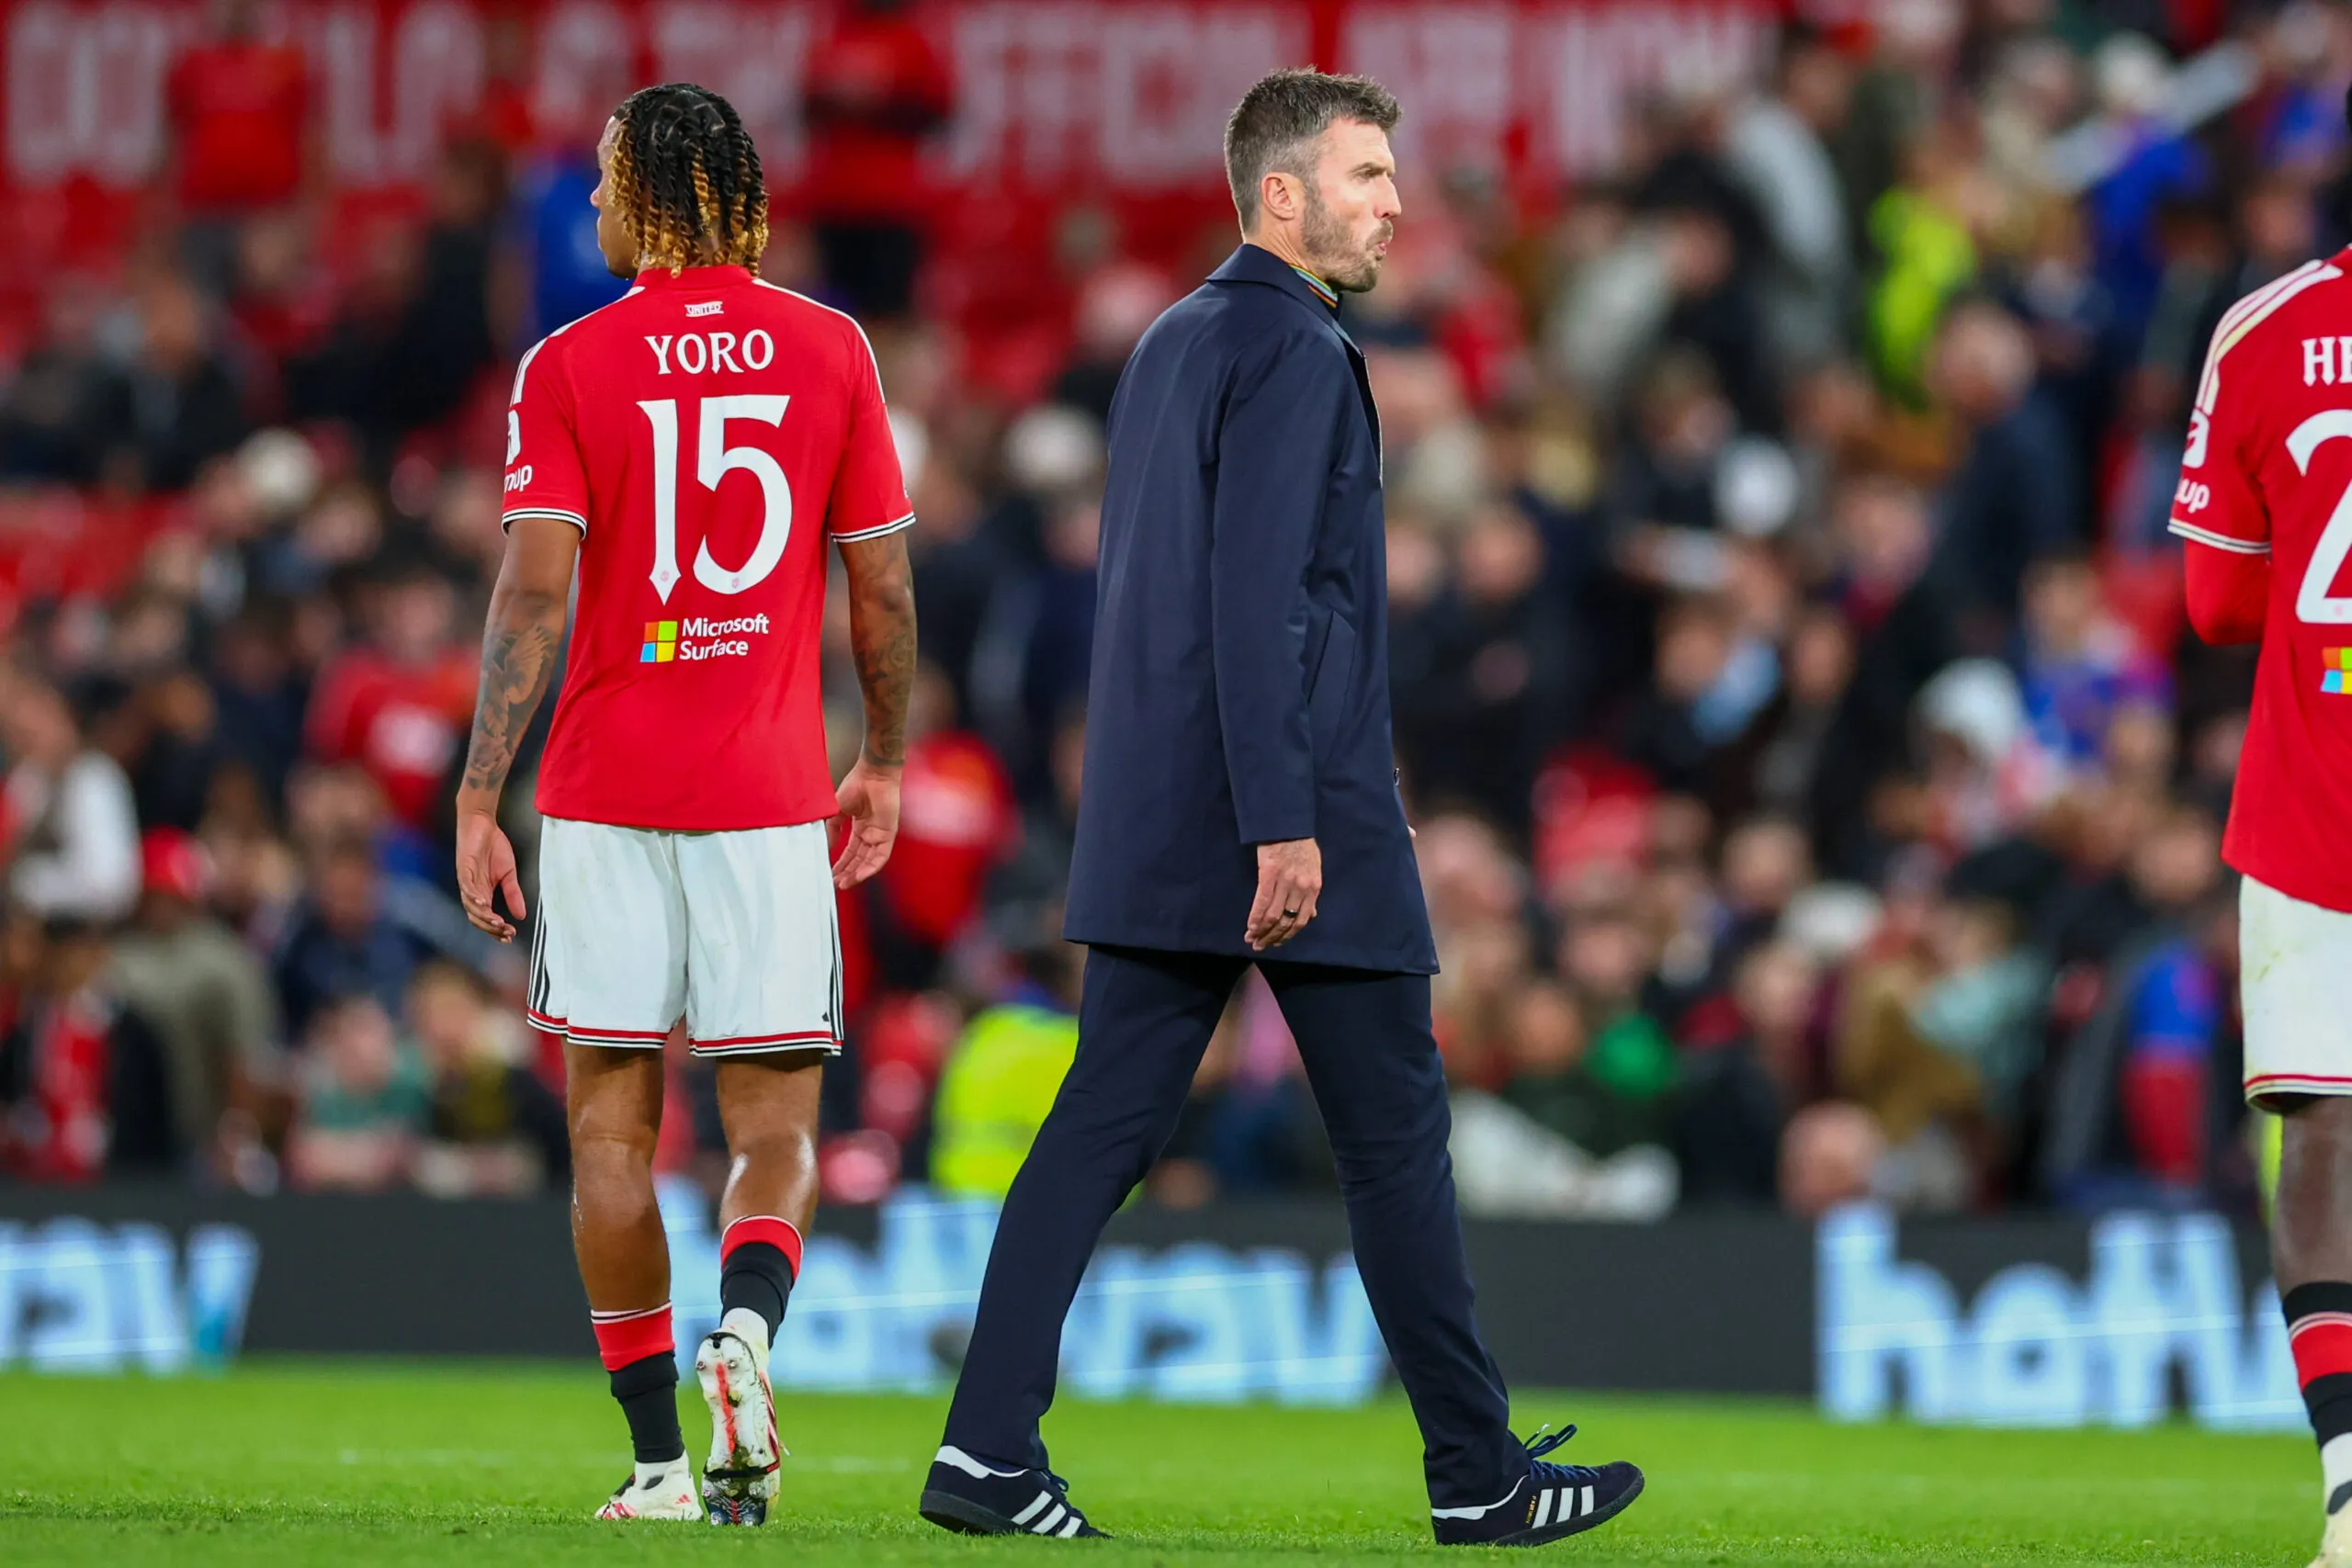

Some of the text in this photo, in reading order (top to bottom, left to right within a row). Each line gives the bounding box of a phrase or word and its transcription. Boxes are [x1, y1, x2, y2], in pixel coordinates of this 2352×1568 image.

[643, 329, 775, 375] YORO
[636, 394, 793, 606] 15
[682, 613, 770, 637] Microsoft
[679, 639, 749, 660] Surface
